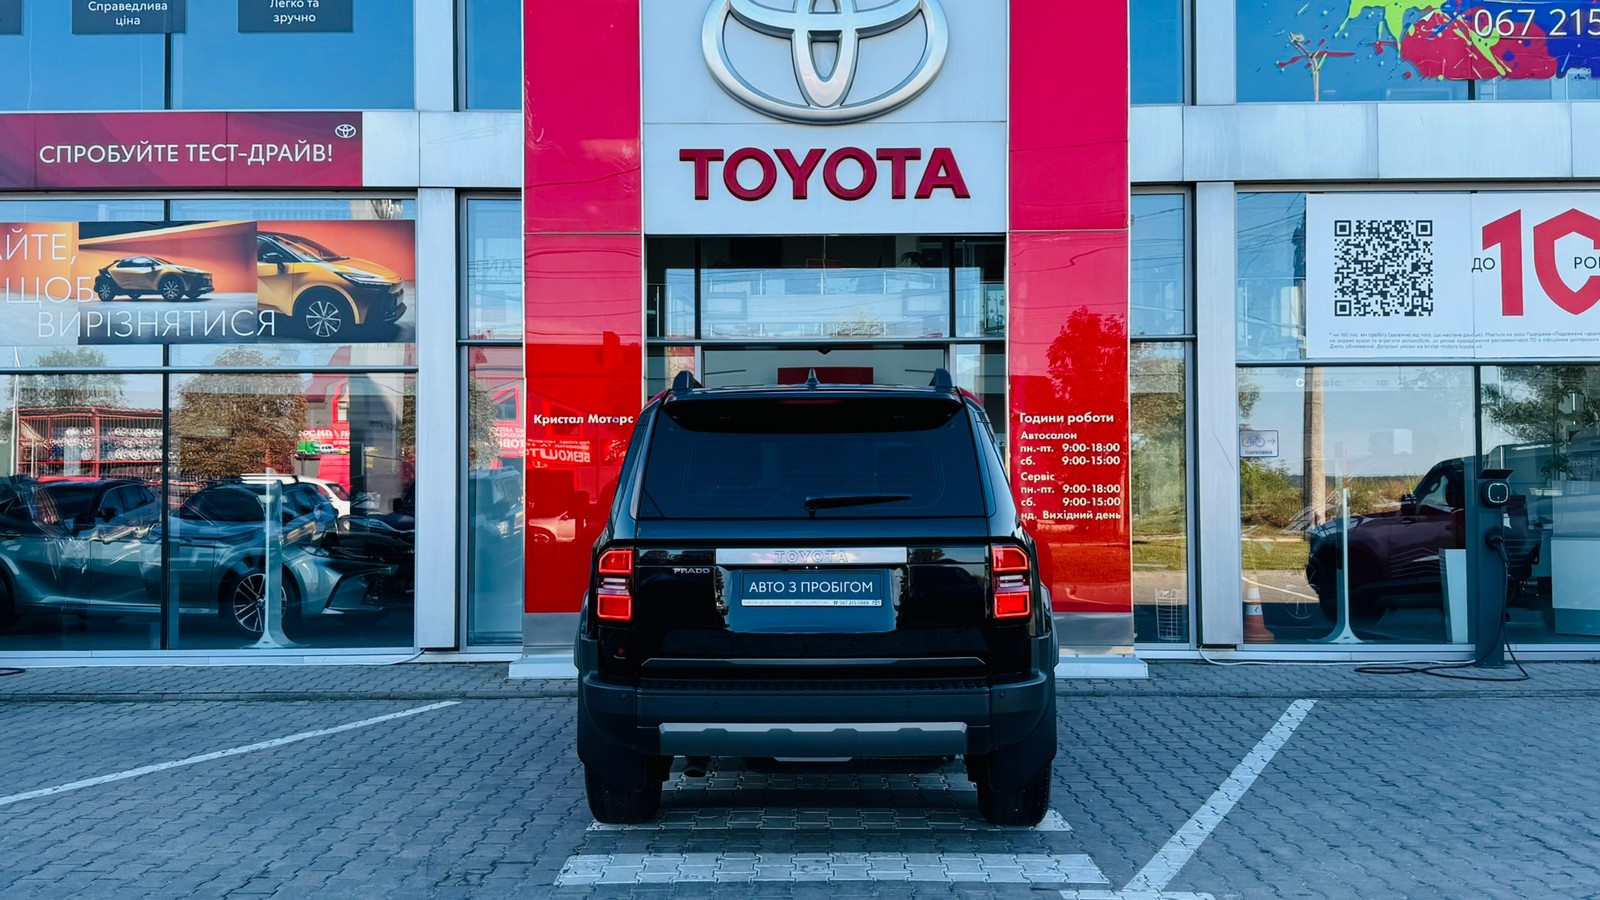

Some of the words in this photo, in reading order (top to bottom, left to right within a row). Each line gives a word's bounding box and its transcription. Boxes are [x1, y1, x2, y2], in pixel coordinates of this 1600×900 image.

[88, 1, 168, 13] Справедлива
[306, 0, 320, 8] та
[115, 15, 141, 27] ціна
[273, 14, 316, 24] зручно
[1474, 9, 1536, 37] 067
[1549, 8, 1600, 36] 215
[39, 139, 178, 164] СПРОБУЙТЕ
[186, 139, 333, 166] ТЕСТ-ДРАЙВ!
[679, 146, 971, 201] TOYOTA
[0, 227, 76, 265] ЙТЕ,
[1471, 257, 1496, 273] ДО
[1574, 256, 1600, 270] РО
[6, 276, 95, 308] ЩОБ
[38, 309, 276, 338] ВИРІЗНЯТИСЯ
[534, 414, 584, 426] Кристал
[588, 413, 634, 426] Моторс
[1020, 412, 1064, 424] Години
[1067, 412, 1114, 425] роботи
[1021, 431, 1077, 440] Автосалон
[1062, 443, 1120, 452] 9:00-18:00
[1020, 456, 1035, 465] сб.
[1062, 456, 1120, 465] 9:00-15:00
[1021, 471, 1055, 483] Сервіс
[1062, 484, 1121, 493] 9:00-18:00
[1021, 497, 1036, 506] сб.
[1062, 497, 1121, 506] 9:00-15:00
[1043, 510, 1093, 520] Вихідний
[774, 550, 848, 563] TOYOTA
[749, 581, 785, 593] АВТО
[788, 581, 797, 593] З
[801, 581, 873, 593] ПРОБІГОМ
